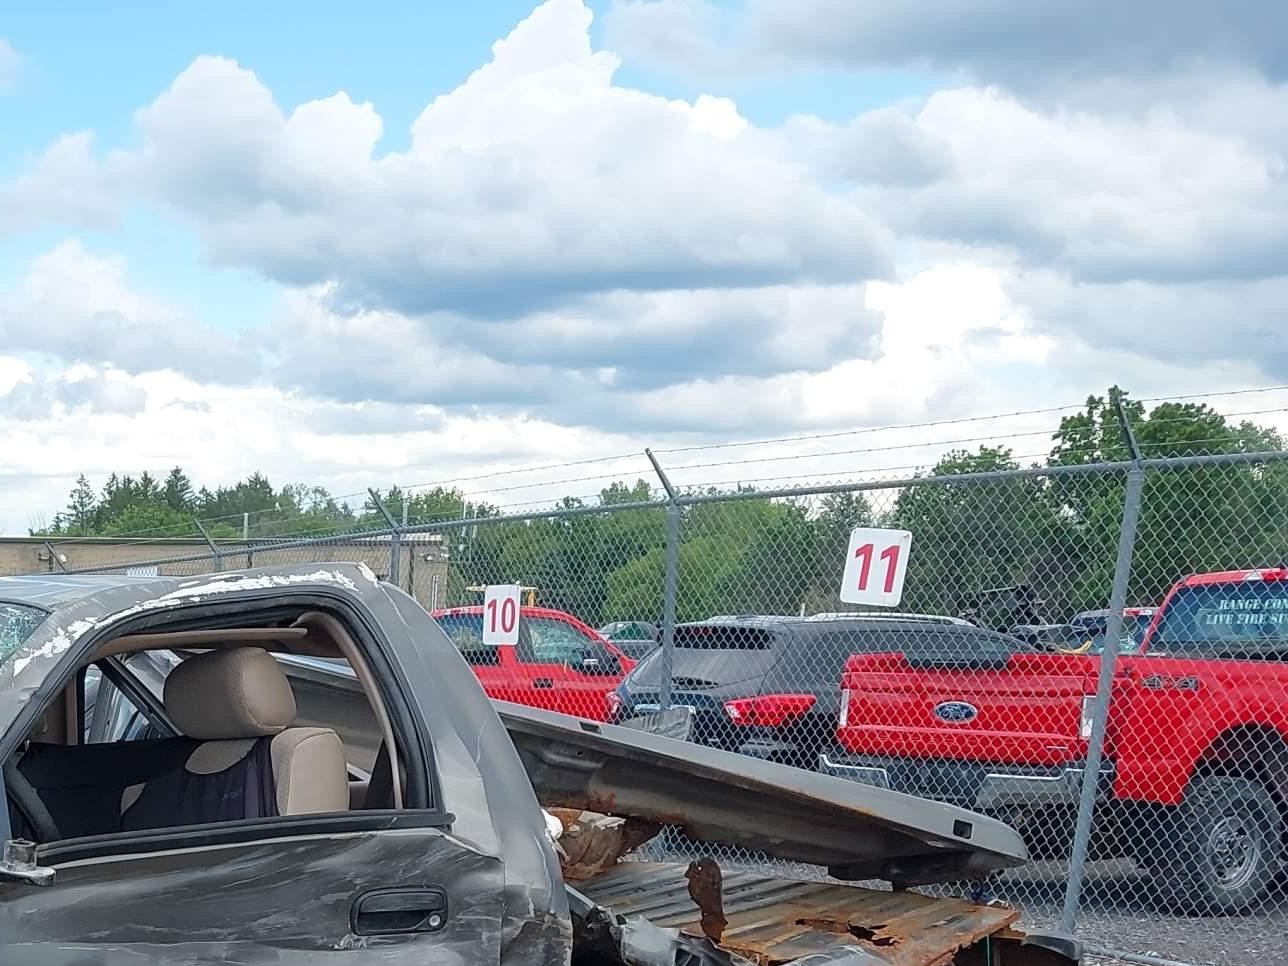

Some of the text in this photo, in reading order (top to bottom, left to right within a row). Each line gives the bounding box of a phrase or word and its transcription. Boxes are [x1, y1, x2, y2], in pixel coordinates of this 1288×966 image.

[855, 543, 900, 593] 11
[487, 597, 516, 633] 10
[1219, 599, 1261, 610] RANGE
[1206, 613, 1234, 625] LIVE
[1237, 613, 1268, 625] FIRE
